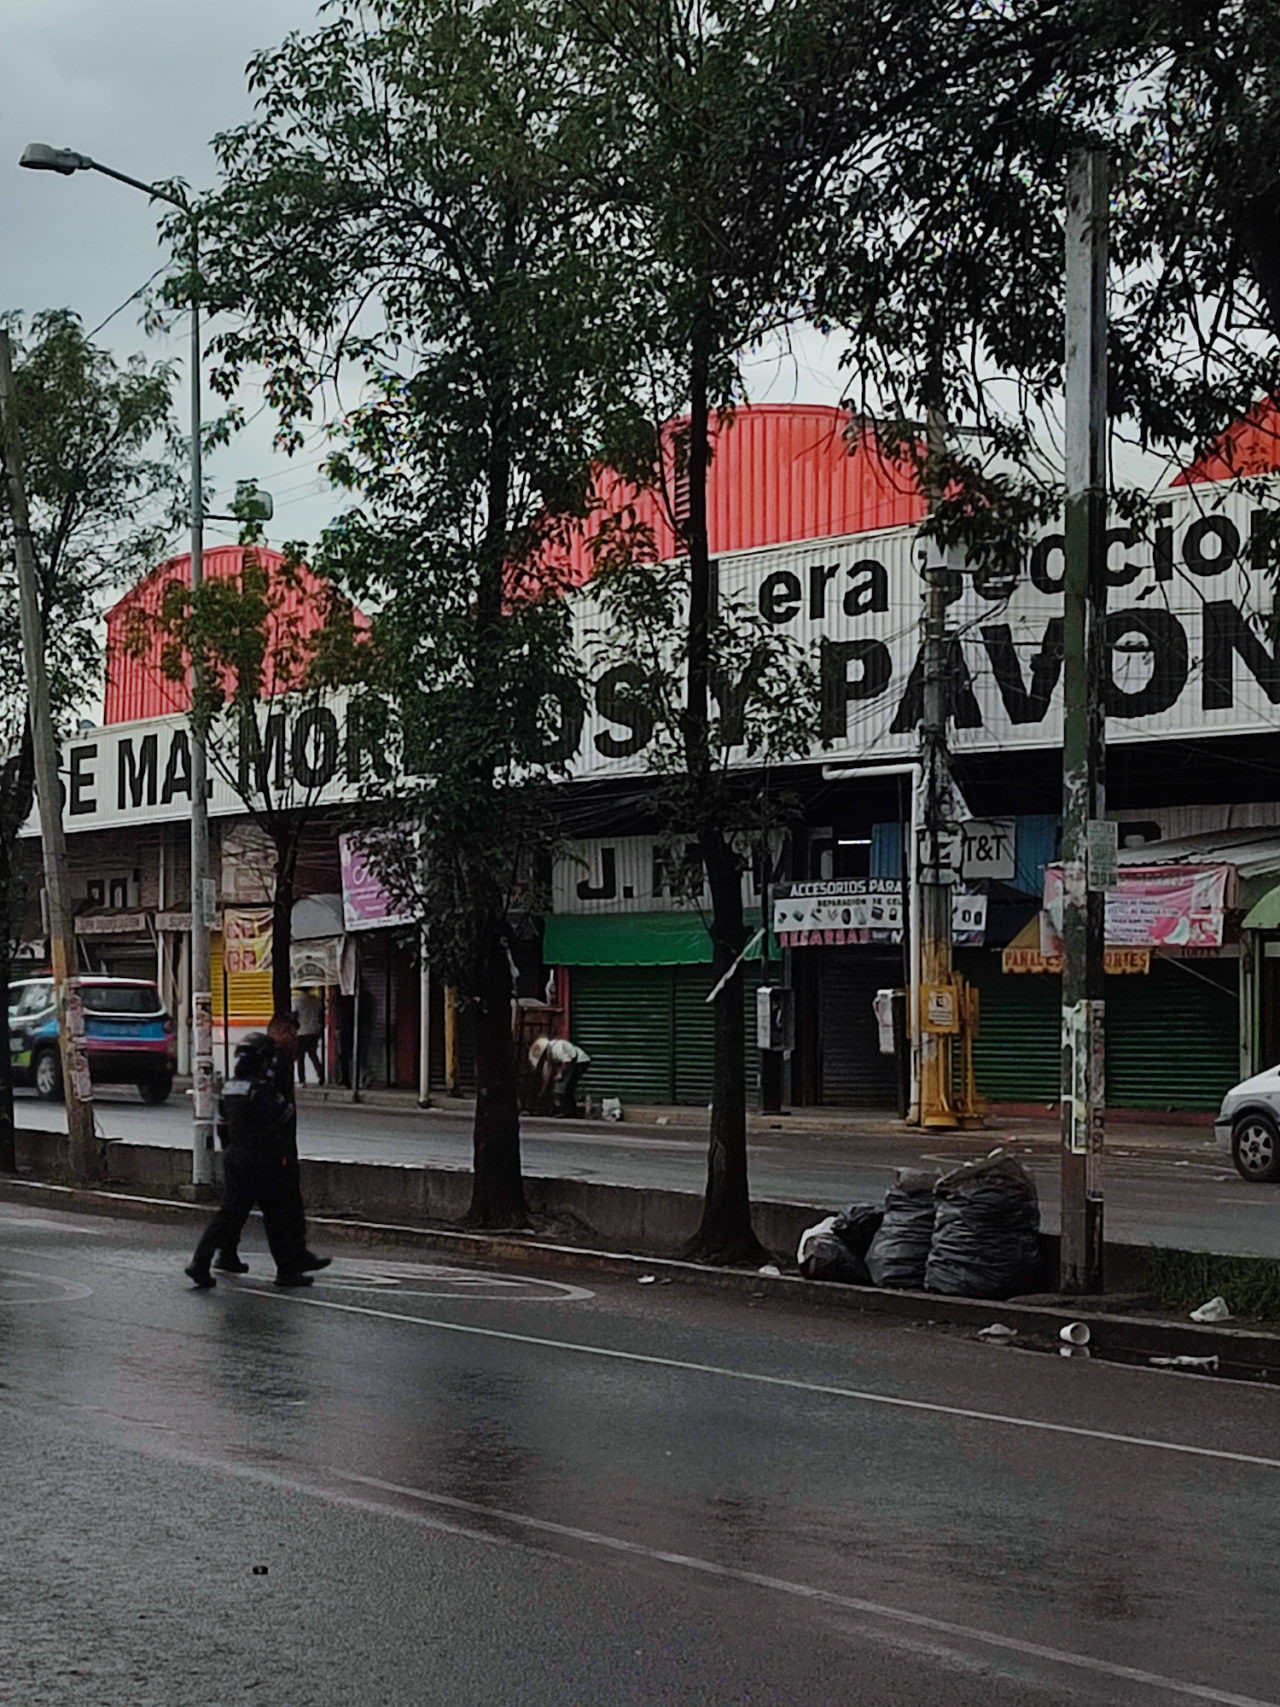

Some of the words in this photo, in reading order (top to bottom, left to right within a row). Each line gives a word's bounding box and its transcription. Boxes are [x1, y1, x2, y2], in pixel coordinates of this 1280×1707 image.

[759, 560, 888, 623] era
[959, 835, 1006, 861] T&T
[789, 880, 866, 897] ACCESORIOS
[867, 879, 901, 895] PARA
